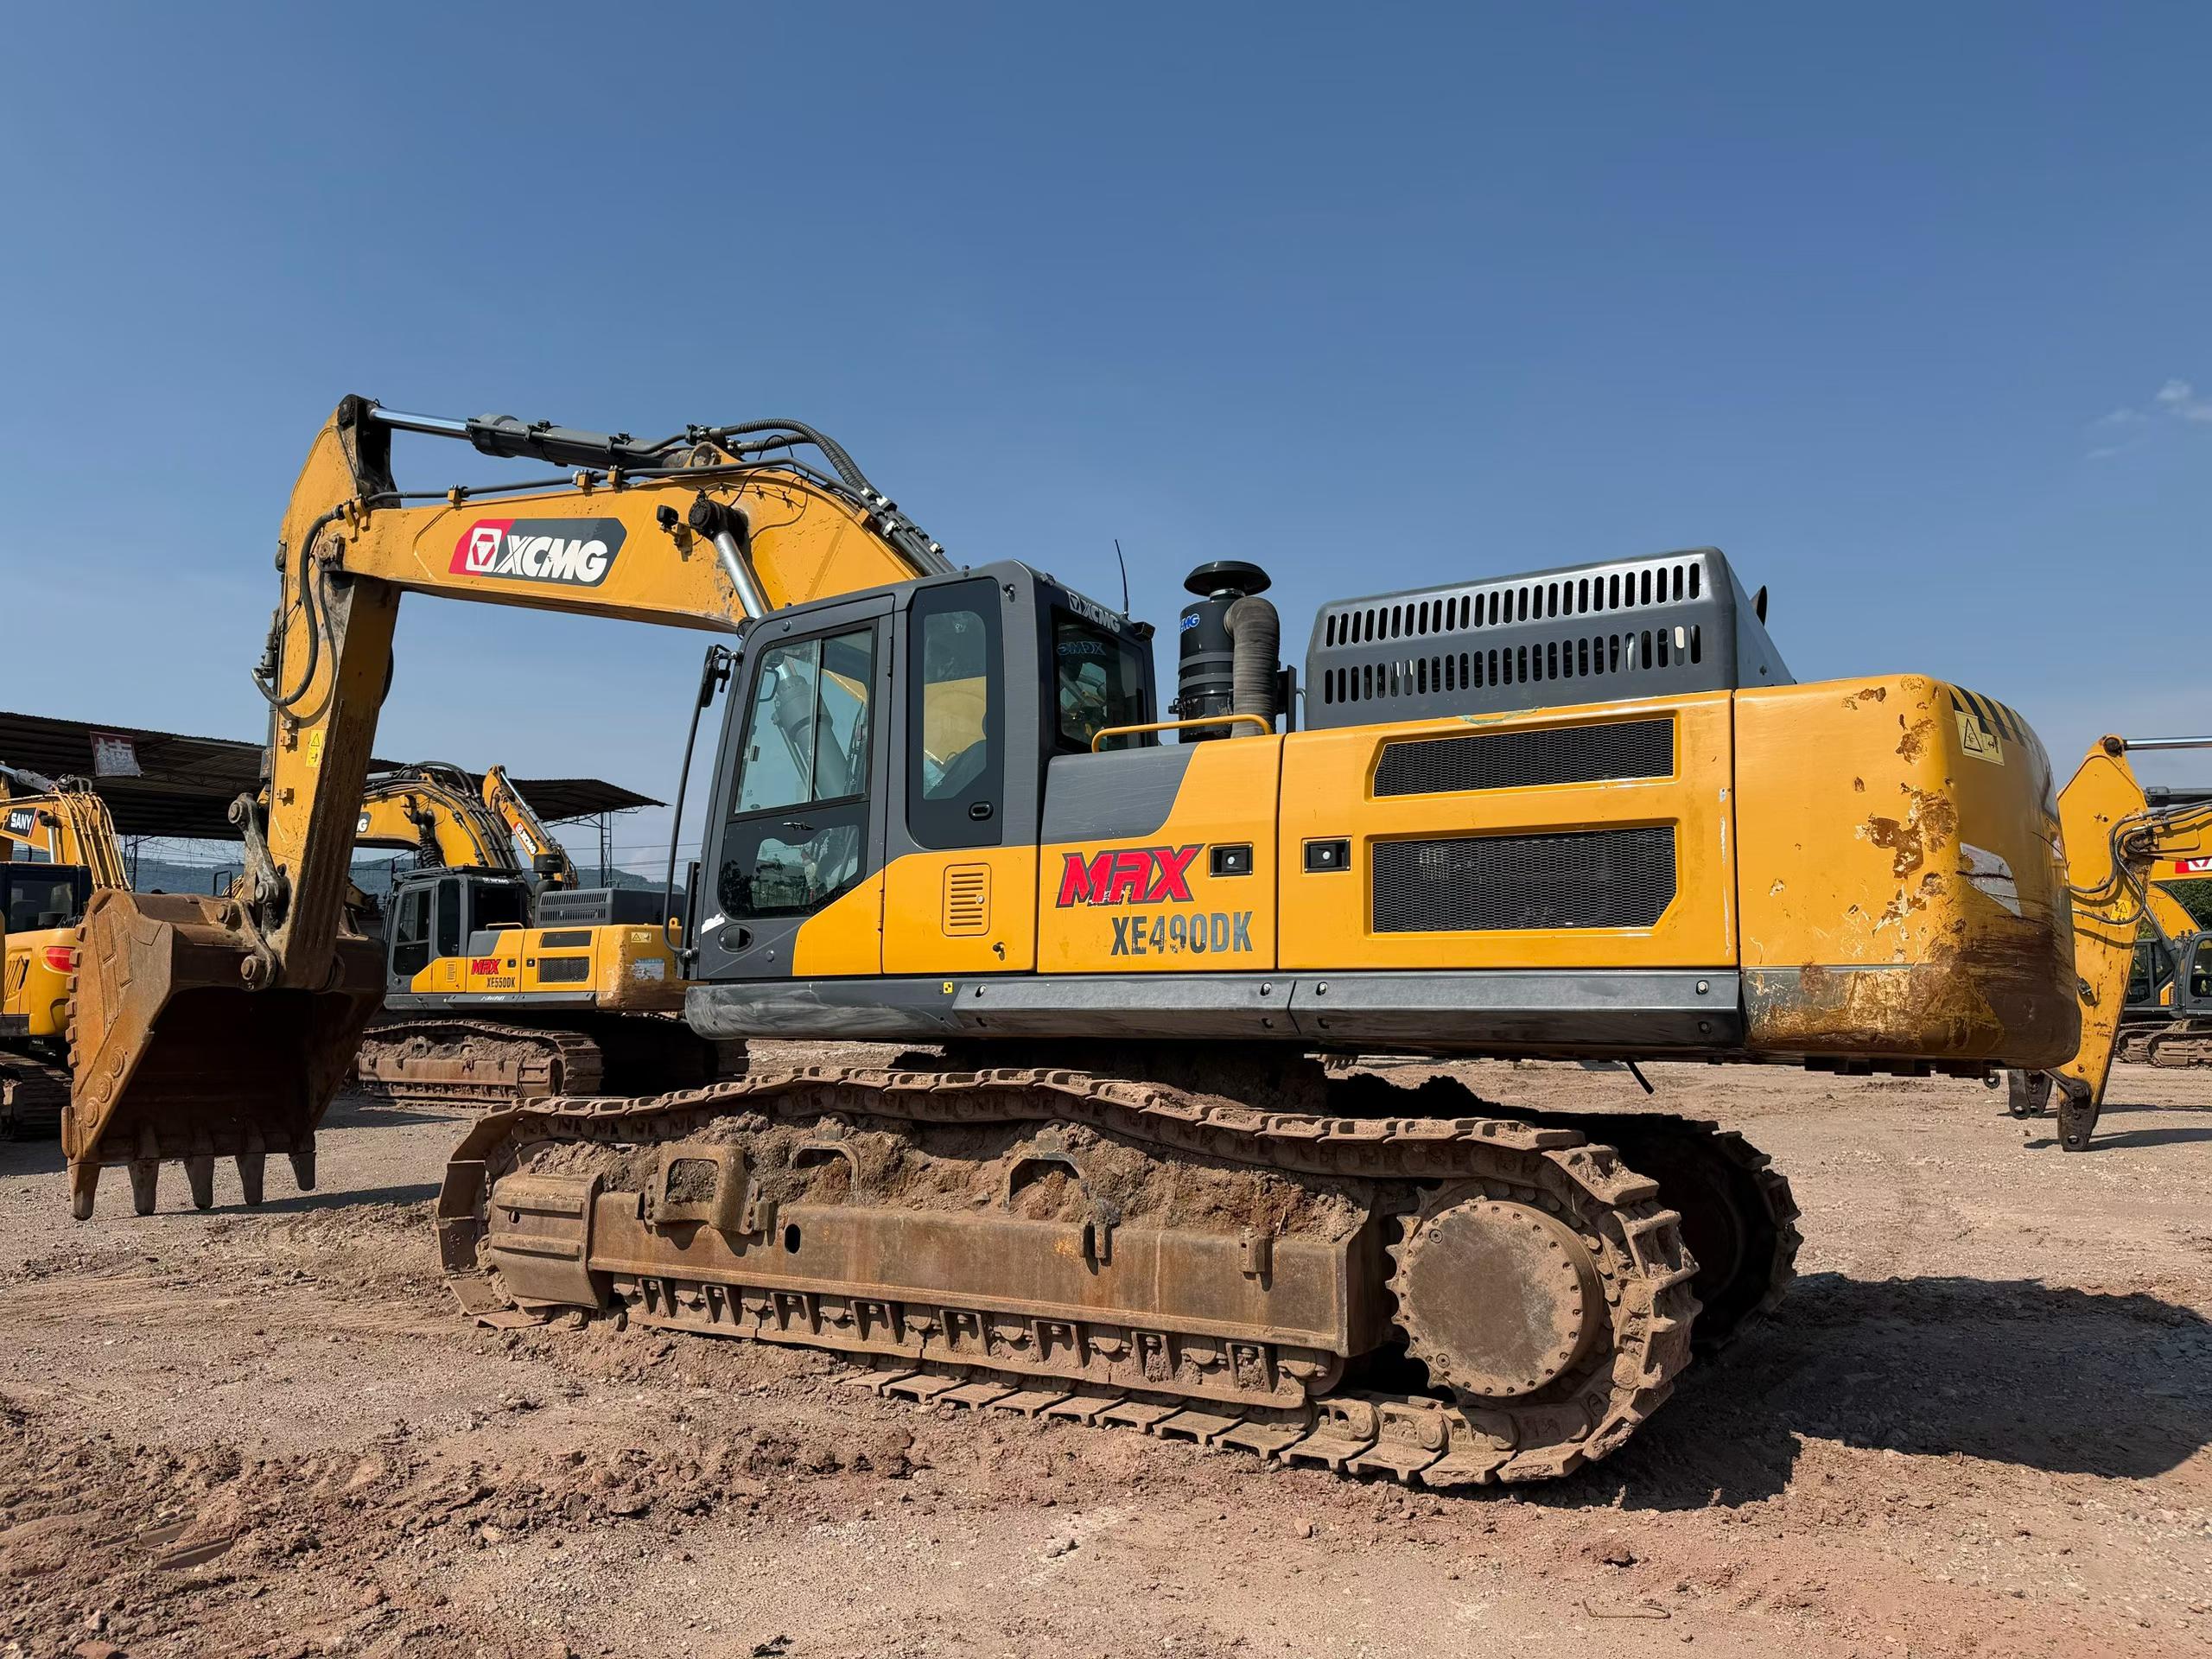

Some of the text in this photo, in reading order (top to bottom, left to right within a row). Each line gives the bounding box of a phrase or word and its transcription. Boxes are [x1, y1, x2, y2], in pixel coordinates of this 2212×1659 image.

[493, 534, 608, 582] XCMG
[1081, 599, 1121, 632] XCMG
[10, 812, 33, 830] SANY
[1055, 842, 1206, 908] MAX
[1110, 911, 1253, 956] XE490DK
[471, 958, 501, 975] MAX
[486, 976, 515, 988] XE550DK
